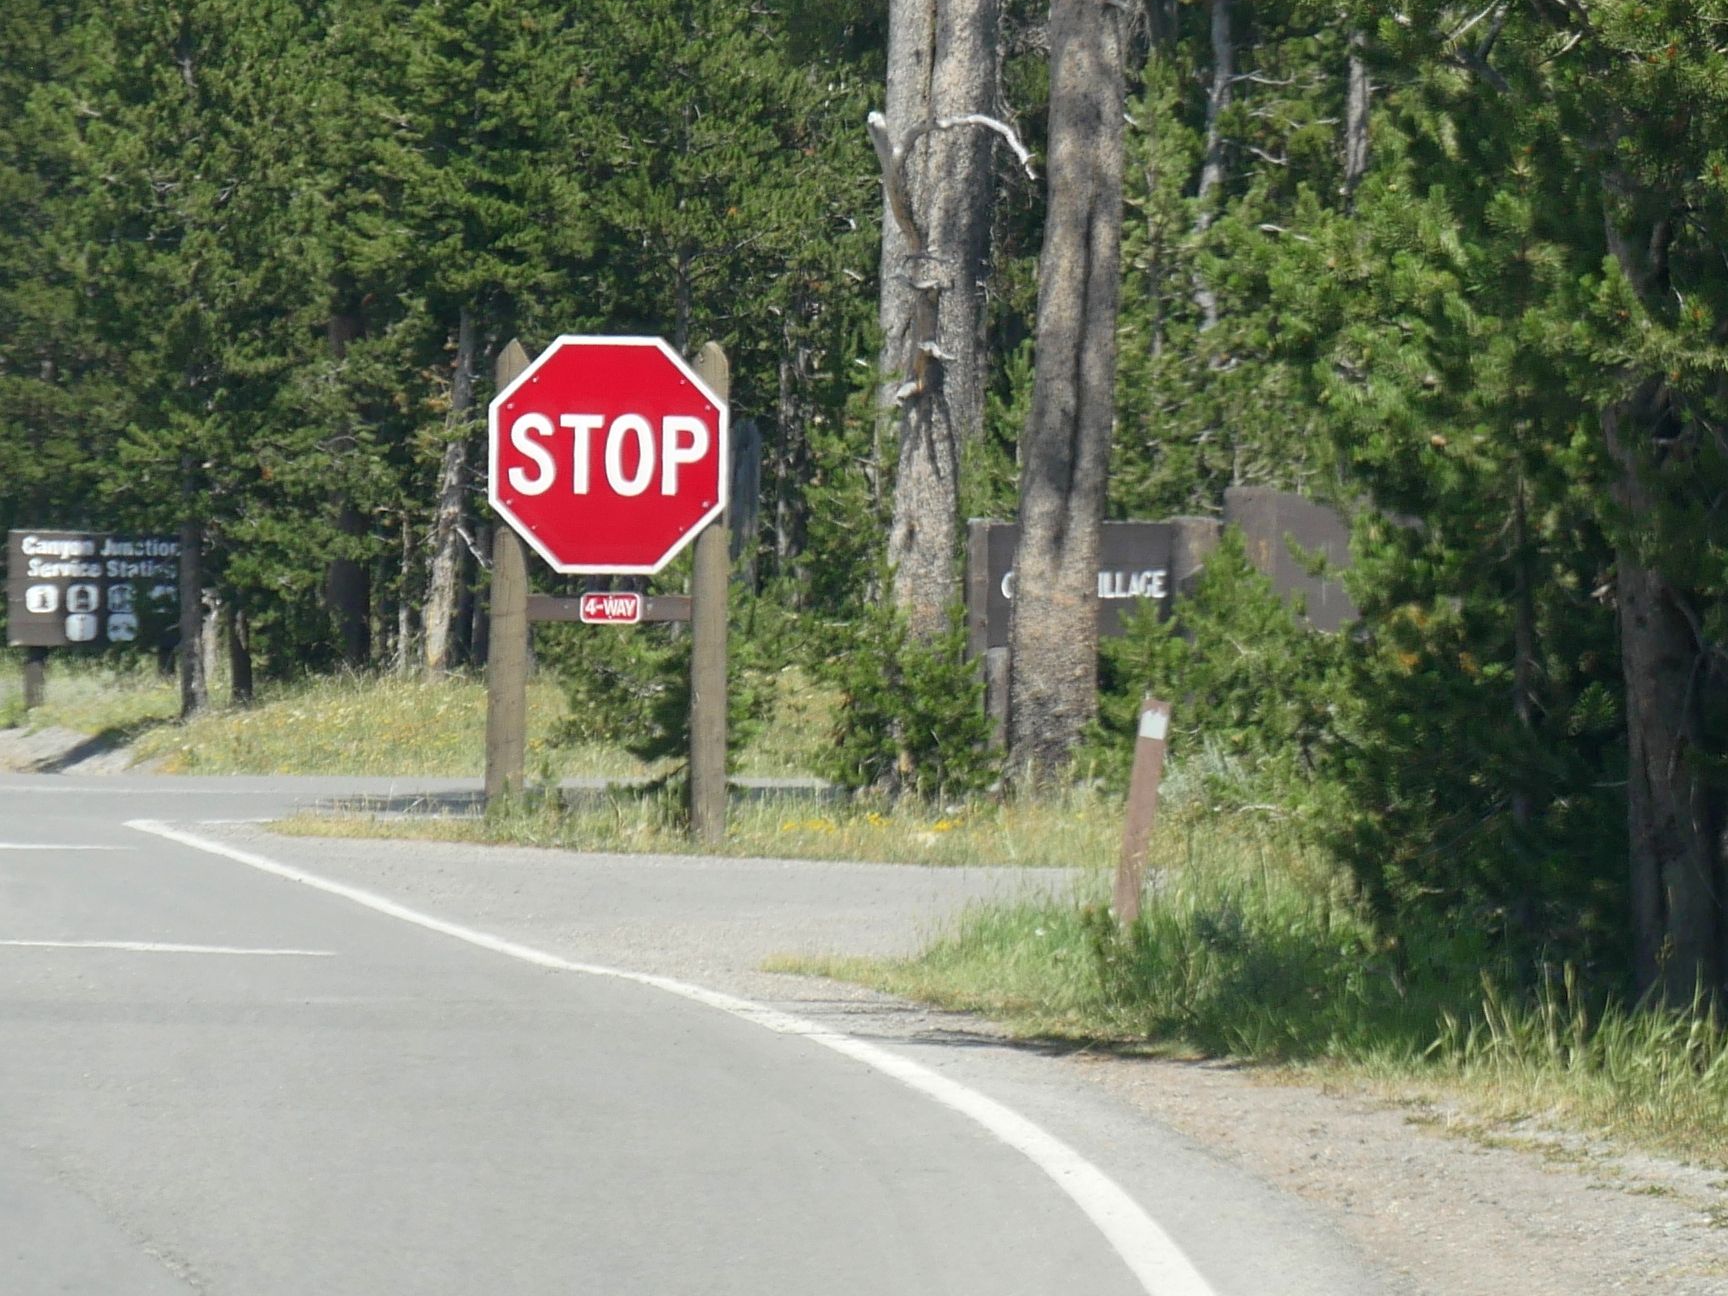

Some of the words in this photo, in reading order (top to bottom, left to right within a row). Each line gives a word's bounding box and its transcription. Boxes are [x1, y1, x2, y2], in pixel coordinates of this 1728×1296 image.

[508, 412, 709, 497] STOP
[21, 536, 95, 560] Canyon
[27, 558, 102, 578] Service
[1097, 569, 1168, 600] ILLAGE
[584, 596, 636, 618] 4-WAY
